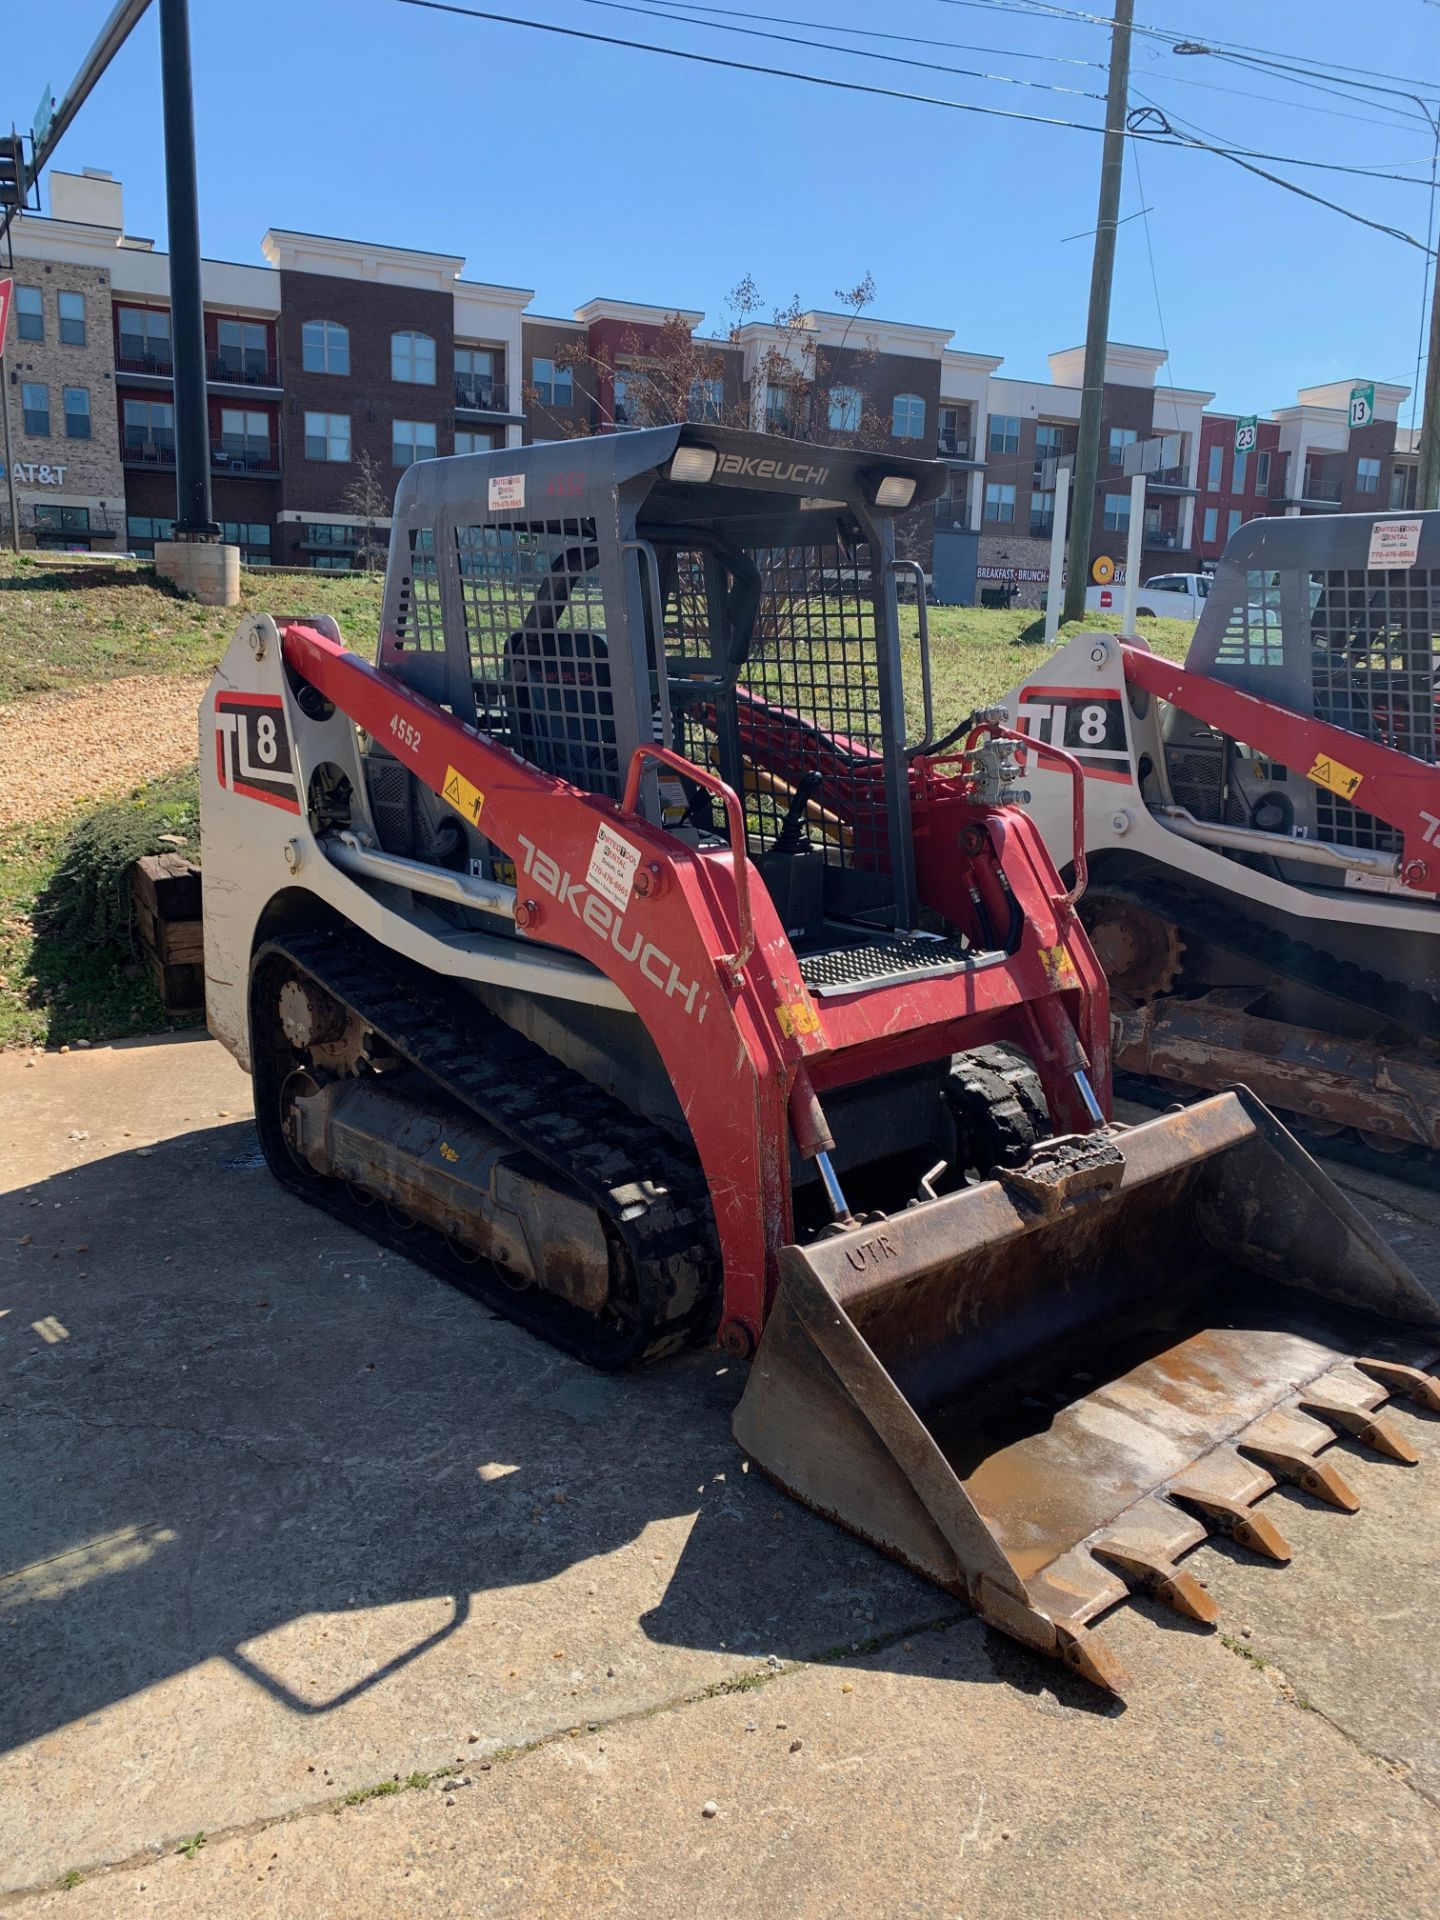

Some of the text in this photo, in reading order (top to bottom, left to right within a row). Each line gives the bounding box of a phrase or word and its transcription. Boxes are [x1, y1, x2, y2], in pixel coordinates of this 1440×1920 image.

[1352, 401, 1365, 422] 13
[1238, 428, 1253, 447] 23
[13, 463, 67, 485] AT&T
[977, 567, 1046, 582] BREAKFAST BRUNCH
[390, 714, 421, 753] 4552
[616, 869, 624, 879] GA
[845, 1235, 897, 1272] UTR
